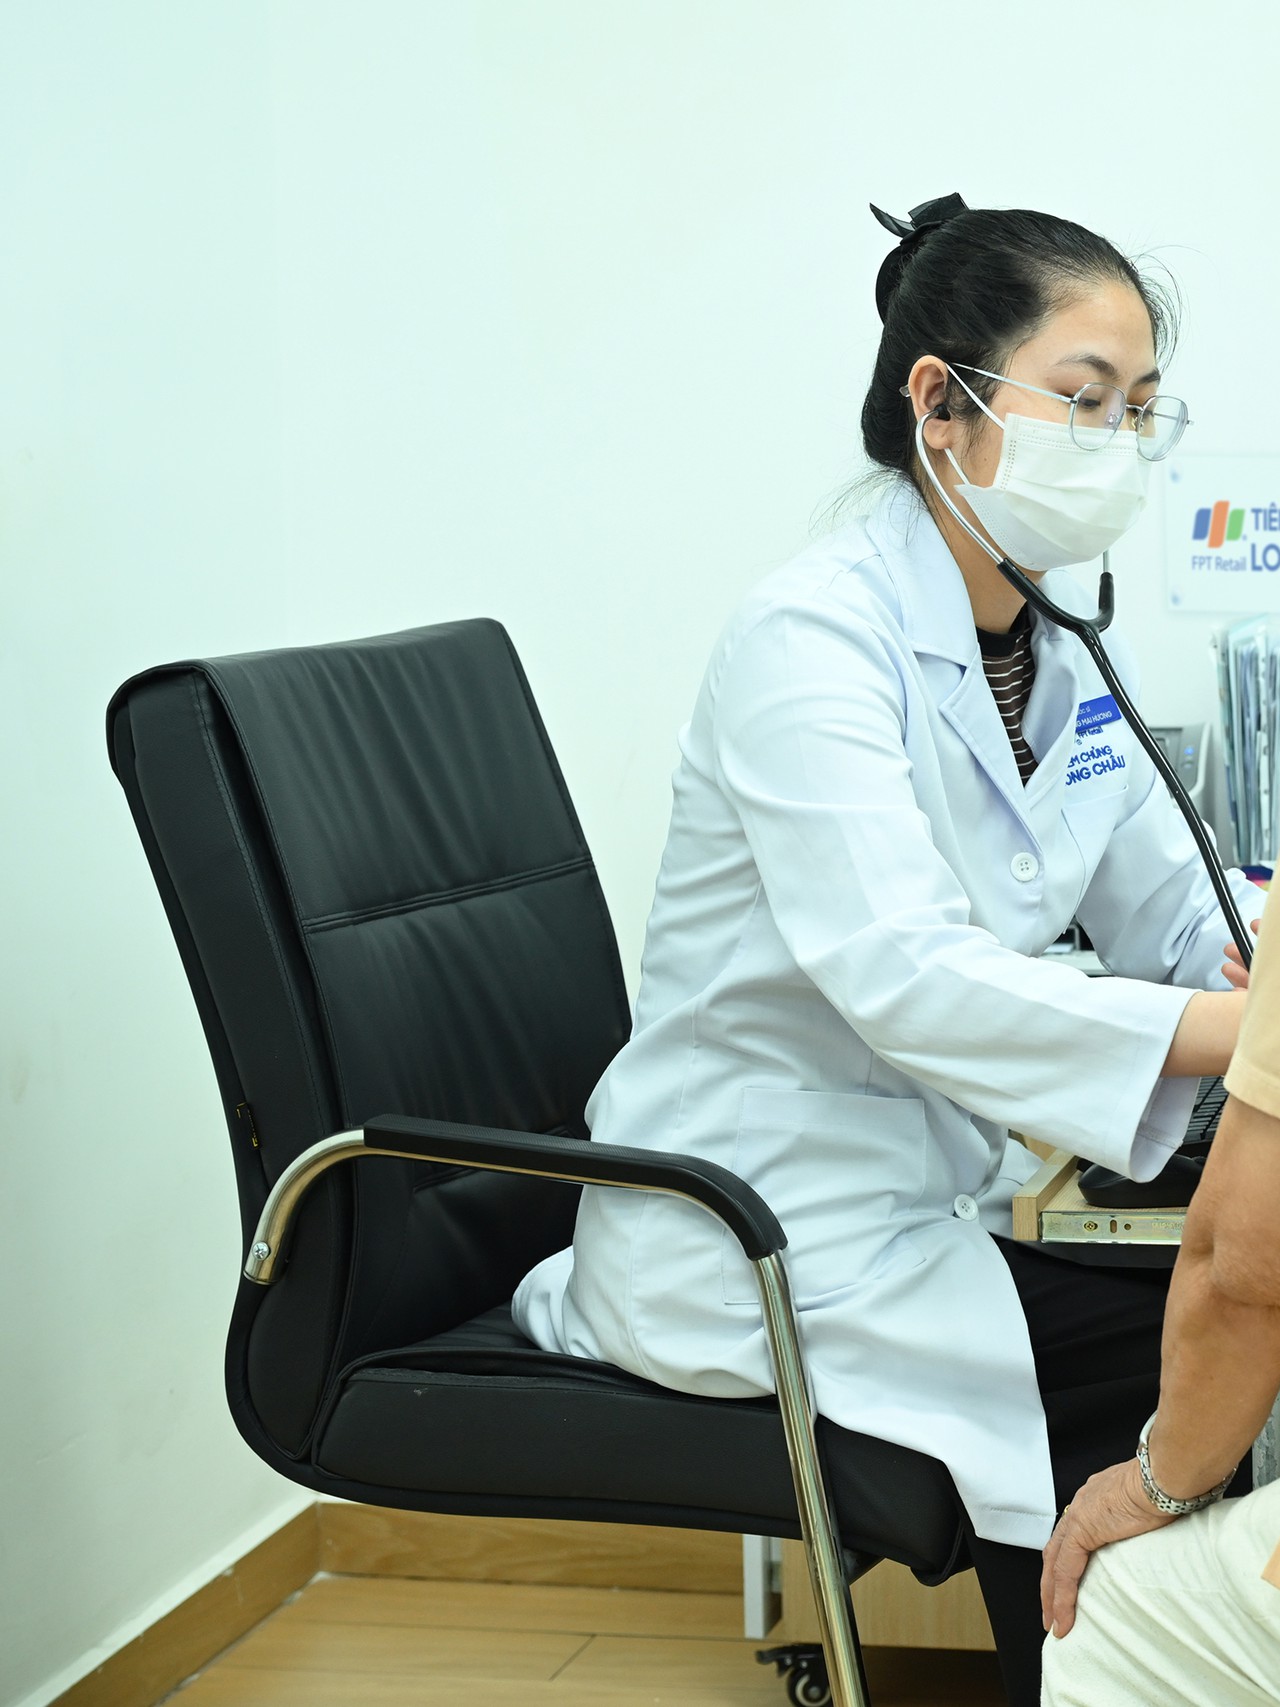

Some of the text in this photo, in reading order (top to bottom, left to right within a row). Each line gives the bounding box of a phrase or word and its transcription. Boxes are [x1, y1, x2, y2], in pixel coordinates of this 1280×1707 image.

[1191, 556, 1247, 572] FPT Retail
[1080, 745, 1112, 762] CHỦNG
[1092, 754, 1126, 775] CHÂU
